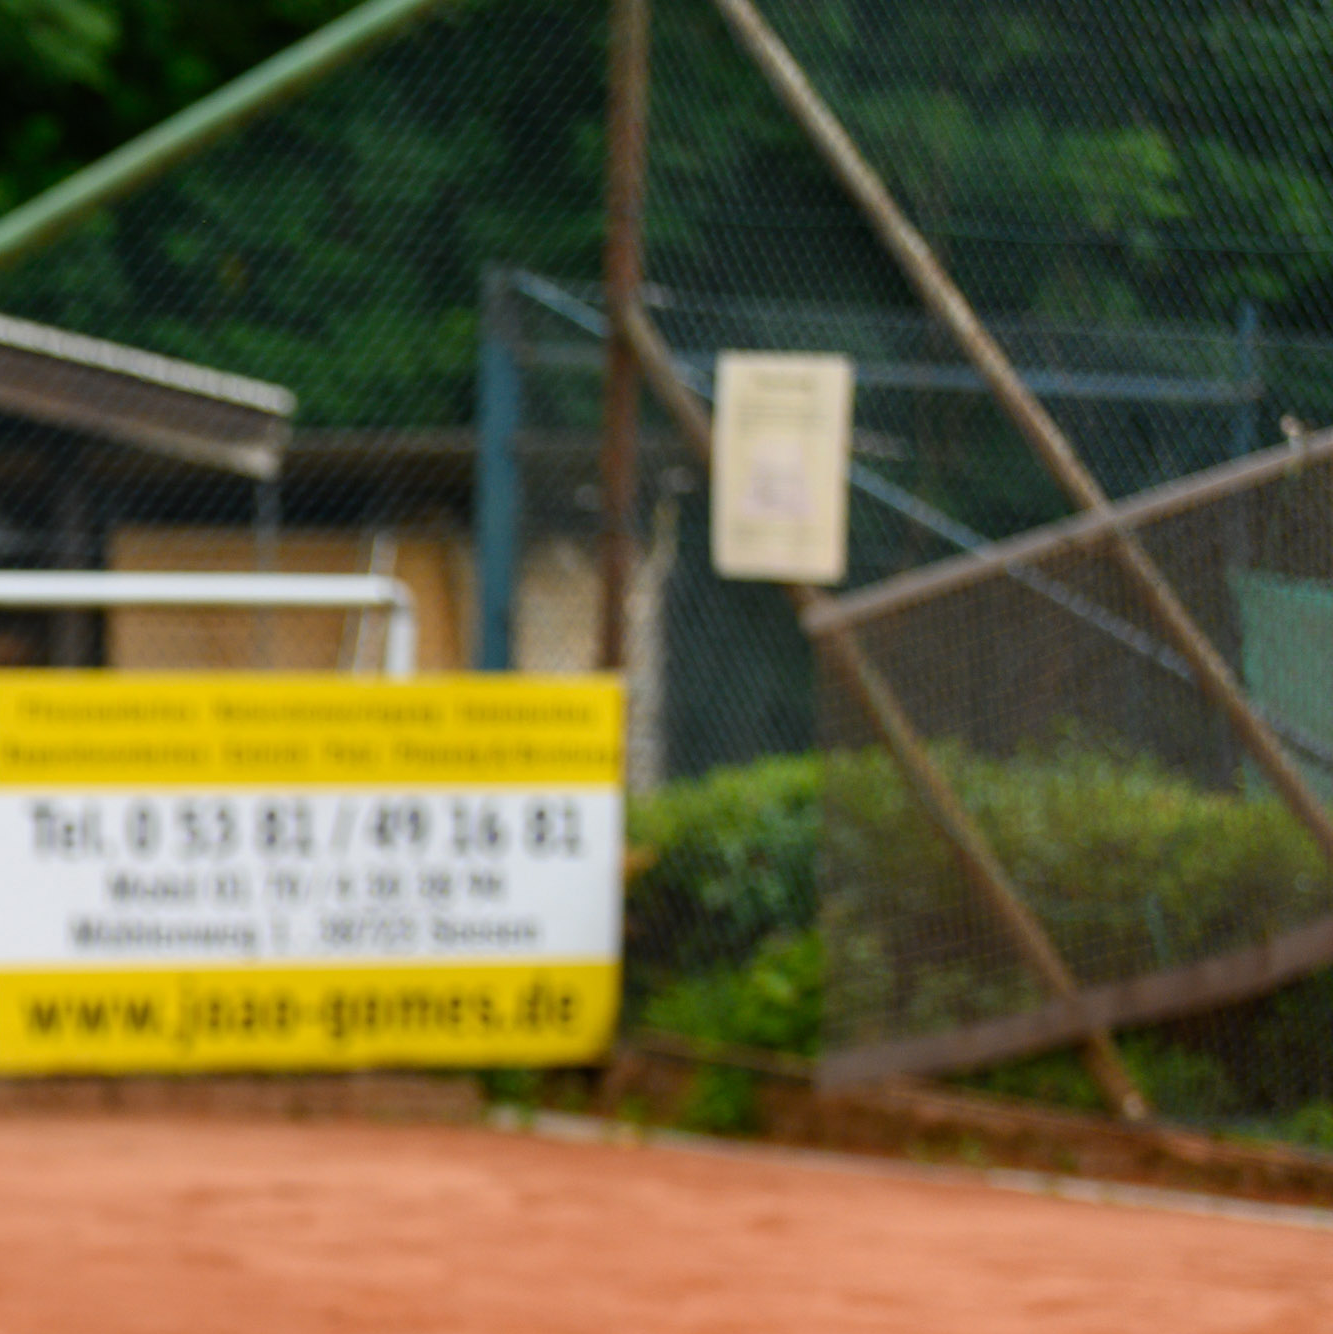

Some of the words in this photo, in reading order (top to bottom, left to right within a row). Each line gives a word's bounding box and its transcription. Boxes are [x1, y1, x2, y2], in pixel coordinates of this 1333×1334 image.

[25, 802, 113, 858] Tel.
[128, 802, 160, 855] 0
[175, 803, 237, 856] 53
[255, 802, 317, 855] 81
[366, 801, 431, 855] 49
[448, 801, 508, 854] 16
[524, 801, 585, 854] 81
